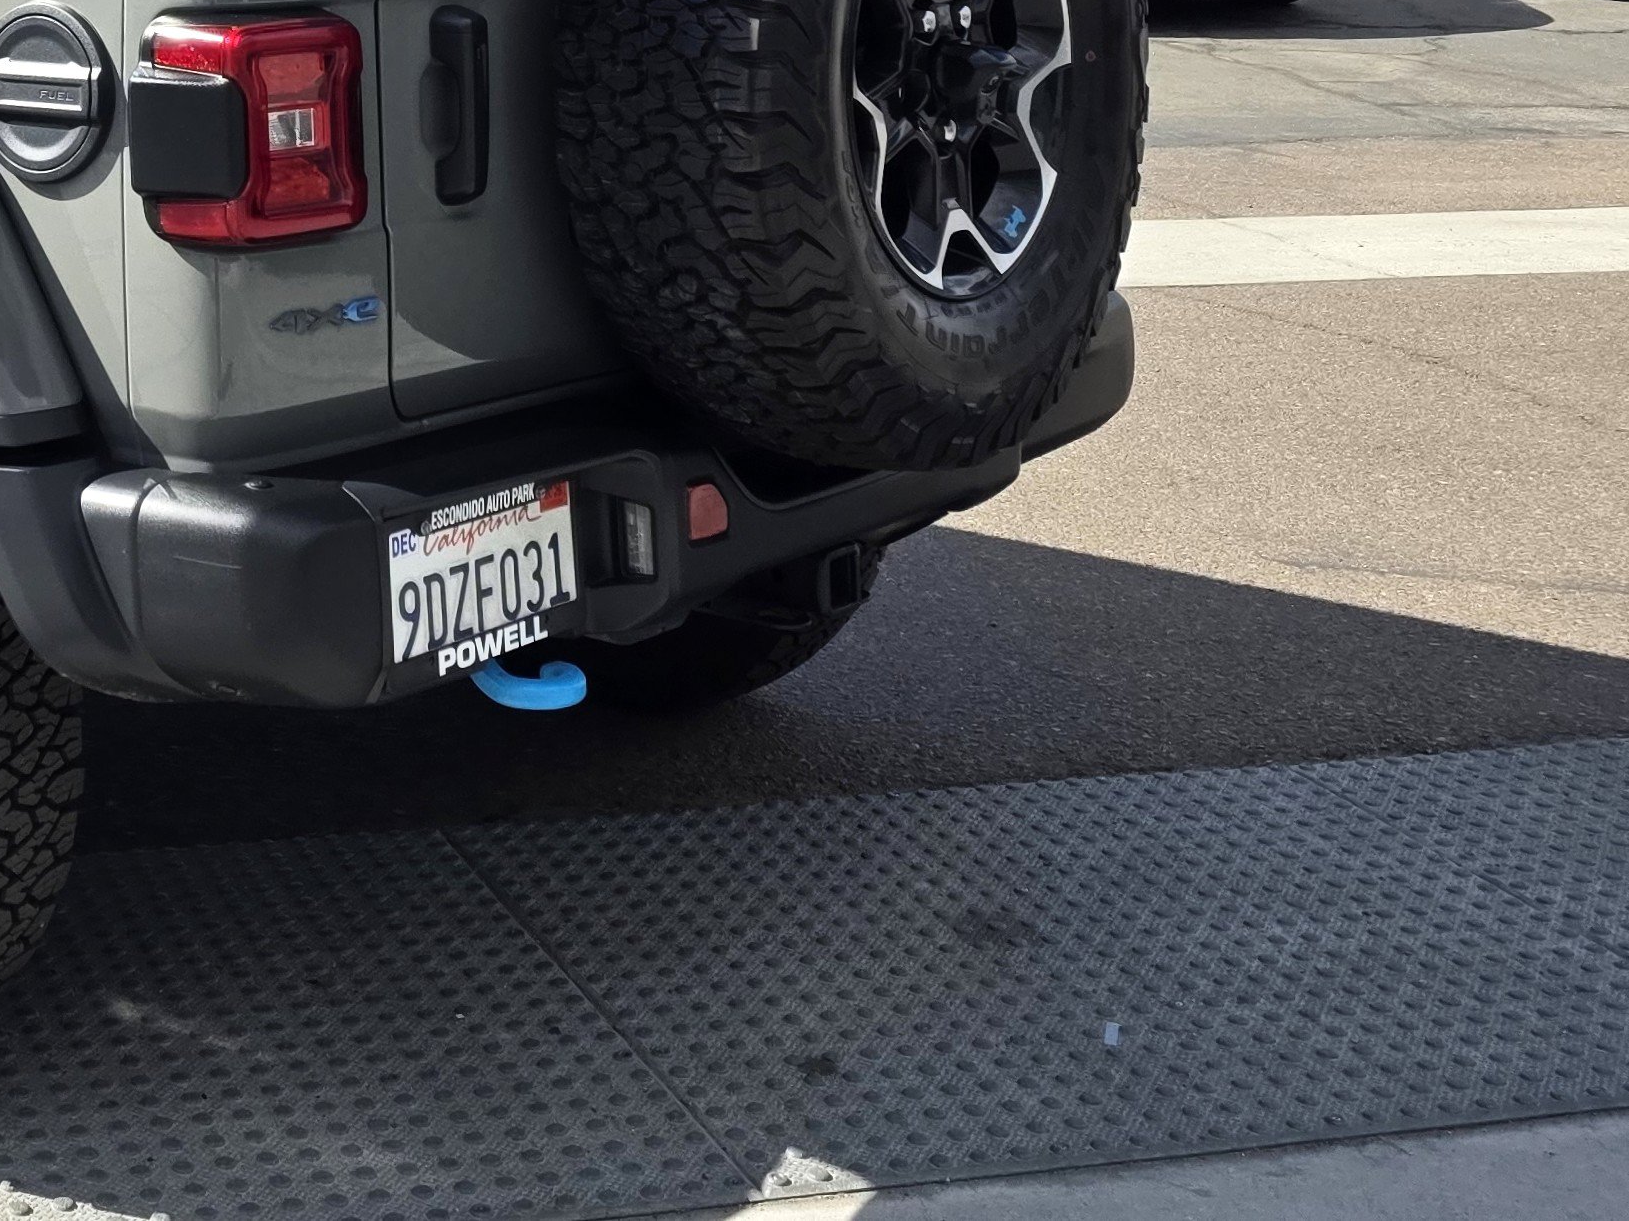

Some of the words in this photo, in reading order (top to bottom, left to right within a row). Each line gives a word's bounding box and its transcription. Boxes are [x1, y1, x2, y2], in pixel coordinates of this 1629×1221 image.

[39, 90, 75, 102] FUEL
[423, 505, 542, 556] California
[430, 496, 484, 530] ESCONDIDO
[486, 489, 511, 514] AUTO
[512, 482, 535, 508] PARK
[391, 531, 417, 559] DEC
[398, 531, 571, 661] 9DZF031
[437, 614, 549, 677] POWELL
